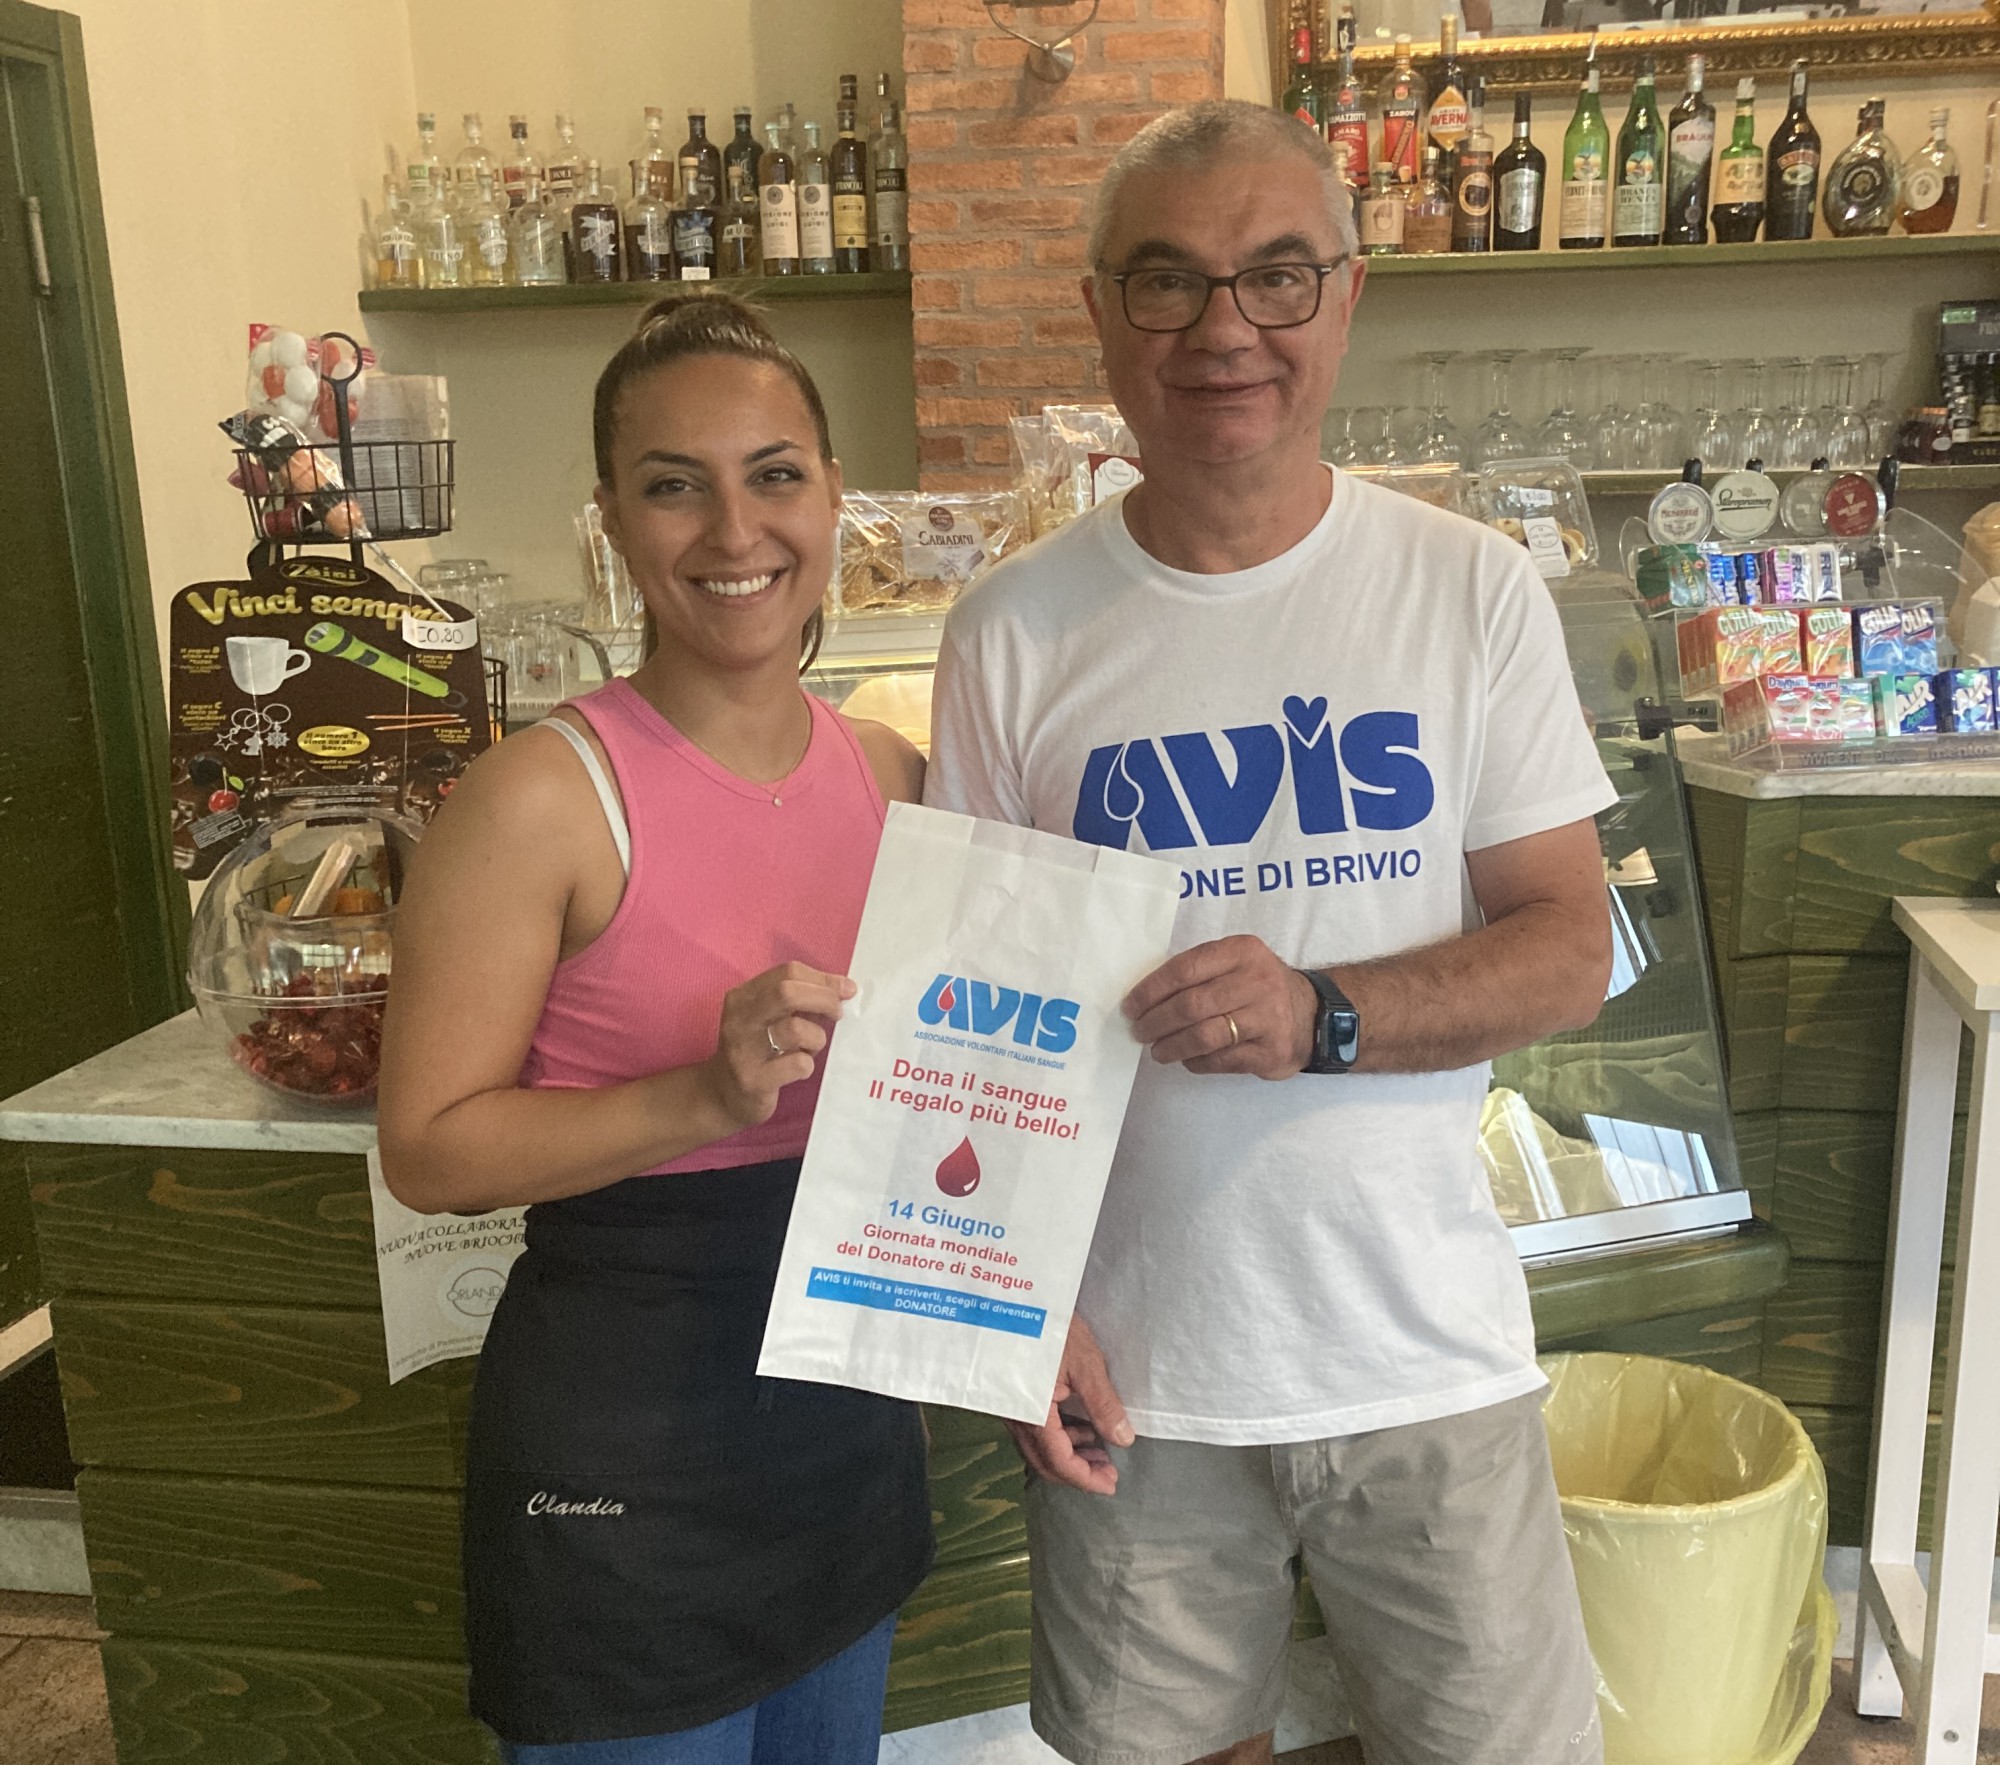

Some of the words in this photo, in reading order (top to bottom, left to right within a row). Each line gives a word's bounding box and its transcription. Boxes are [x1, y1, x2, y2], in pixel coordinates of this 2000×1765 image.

[1333, 128, 1361, 137] AMARO
[1389, 110, 1415, 118] ZABOV
[1430, 113, 1468, 126] AVERNA
[186, 586, 303, 626] Vinci
[1901, 607, 1935, 634] OLIA
[1895, 680, 1935, 722] AIR
[1072, 695, 1435, 851] AVIS
[1180, 867, 1246, 899] ONE
[1257, 861, 1293, 892] DI
[1305, 849, 1421, 887] BRIVIO
[917, 973, 1081, 1054] AVIS
[914, 1030, 966, 1048] ASSOCIAZIONE
[966, 1040, 1006, 1057] VOLONTARI
[1006, 1050, 1037, 1064] ITALIANI
[1036, 1056, 1067, 1071] SANGUE
[892, 1058, 954, 1088] Dona
[961, 1071, 976, 1091] il
[981, 1079, 1068, 1112] sangue
[868, 1079, 884, 1099] Il
[890, 1088, 964, 1114] regalo
[969, 1103, 1008, 1125] più
[1013, 1110, 1081, 1140] bello!
[426, 1217, 528, 1240] COLLABORAZ
[888, 1199, 914, 1220] 14
[921, 1205, 1006, 1239] Giugno
[403, 1240, 458, 1264] NUOVE
[863, 1223, 936, 1249] Giornata
[940, 1240, 1018, 1266] mondiale
[836, 1240, 863, 1258] del
[867, 1245, 945, 1271] Donatore
[949, 1261, 965, 1276] di
[970, 1265, 1034, 1291] Sangue
[814, 1271, 840, 1284] AVIS
[842, 1275, 850, 1285] ti
[853, 1278, 883, 1292] invita
[884, 1285, 892, 1293] a
[894, 1284, 943, 1302] iscriverti,
[945, 1293, 977, 1309] scegli
[979, 1300, 990, 1311] di
[992, 1302, 1041, 1322] diventare
[894, 1298, 957, 1318] DONATORE
